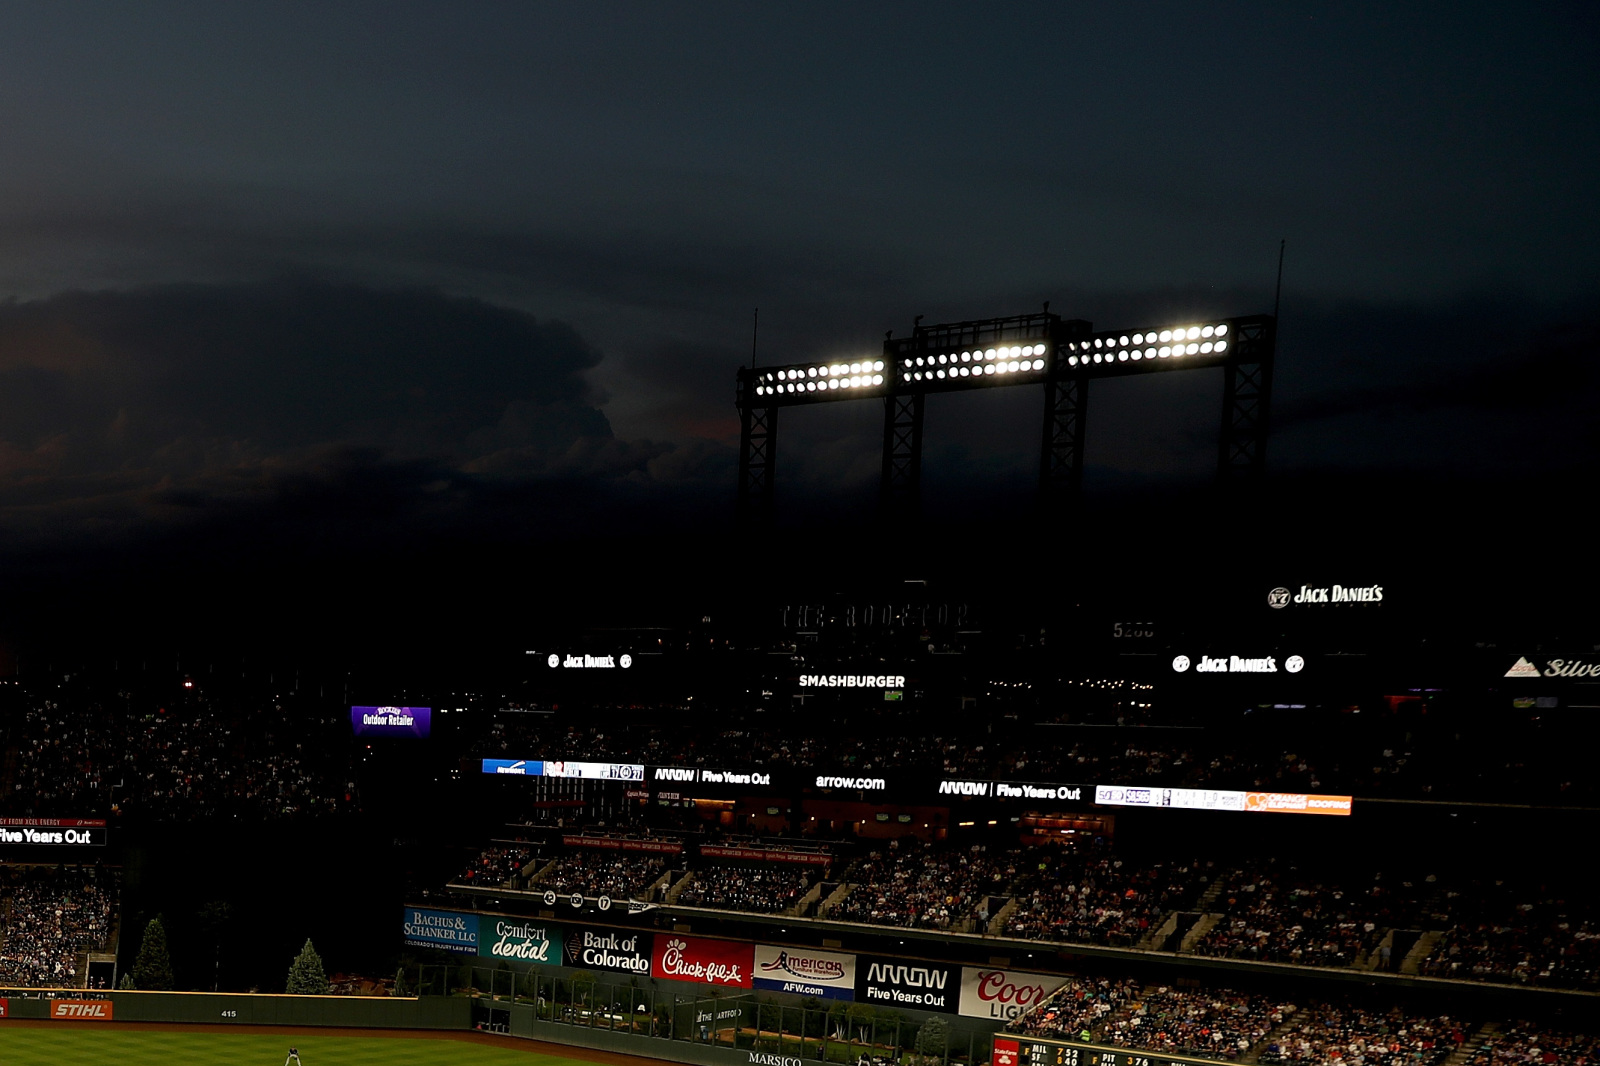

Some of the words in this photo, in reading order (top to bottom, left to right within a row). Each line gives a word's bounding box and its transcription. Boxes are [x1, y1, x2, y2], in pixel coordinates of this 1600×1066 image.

[1294, 585, 1328, 603] JACK
[1331, 584, 1383, 603] DANIEL'S
[563, 654, 584, 668] JACK
[1196, 655, 1228, 673] JACK
[799, 674, 905, 687] SMASHBURGER
[363, 715, 386, 726] Outdoor
[388, 715, 413, 727] Retailer
[702, 770, 723, 783] Five
[724, 771, 750, 784] Years
[751, 772, 770, 784] Out
[816, 775, 885, 789] arrow.com
[996, 784, 1022, 797] Five
[1022, 785, 1056, 799] Years
[1057, 787, 1081, 800] Out
[40, 818, 61, 826] ENERGY
[22, 829, 63, 843] Years
[64, 829, 91, 844] Out
[413, 911, 454, 928] BACHUS
[454, 917, 465, 930] &
[404, 922, 456, 939] SCHANKER
[458, 930, 476, 942] LLC
[496, 921, 547, 941] Comfort
[492, 935, 549, 962] dental
[583, 932, 621, 951] Bank
[623, 935, 638, 952] of
[582, 949, 649, 971] Colorado
[662, 945, 742, 982] Chick-fil-A
[783, 982, 824, 995] AFW.com
[867, 986, 890, 1000] Five
[892, 988, 922, 1004] Years
[924, 993, 945, 1007] Out
[55, 1003, 105, 1017] STIHL
[221, 1010, 236, 1018] 415
[1032, 1044, 1047, 1054] MIL
[1031, 1052, 1041, 1061] SF
[1102, 1053, 1115, 1062] PIT
